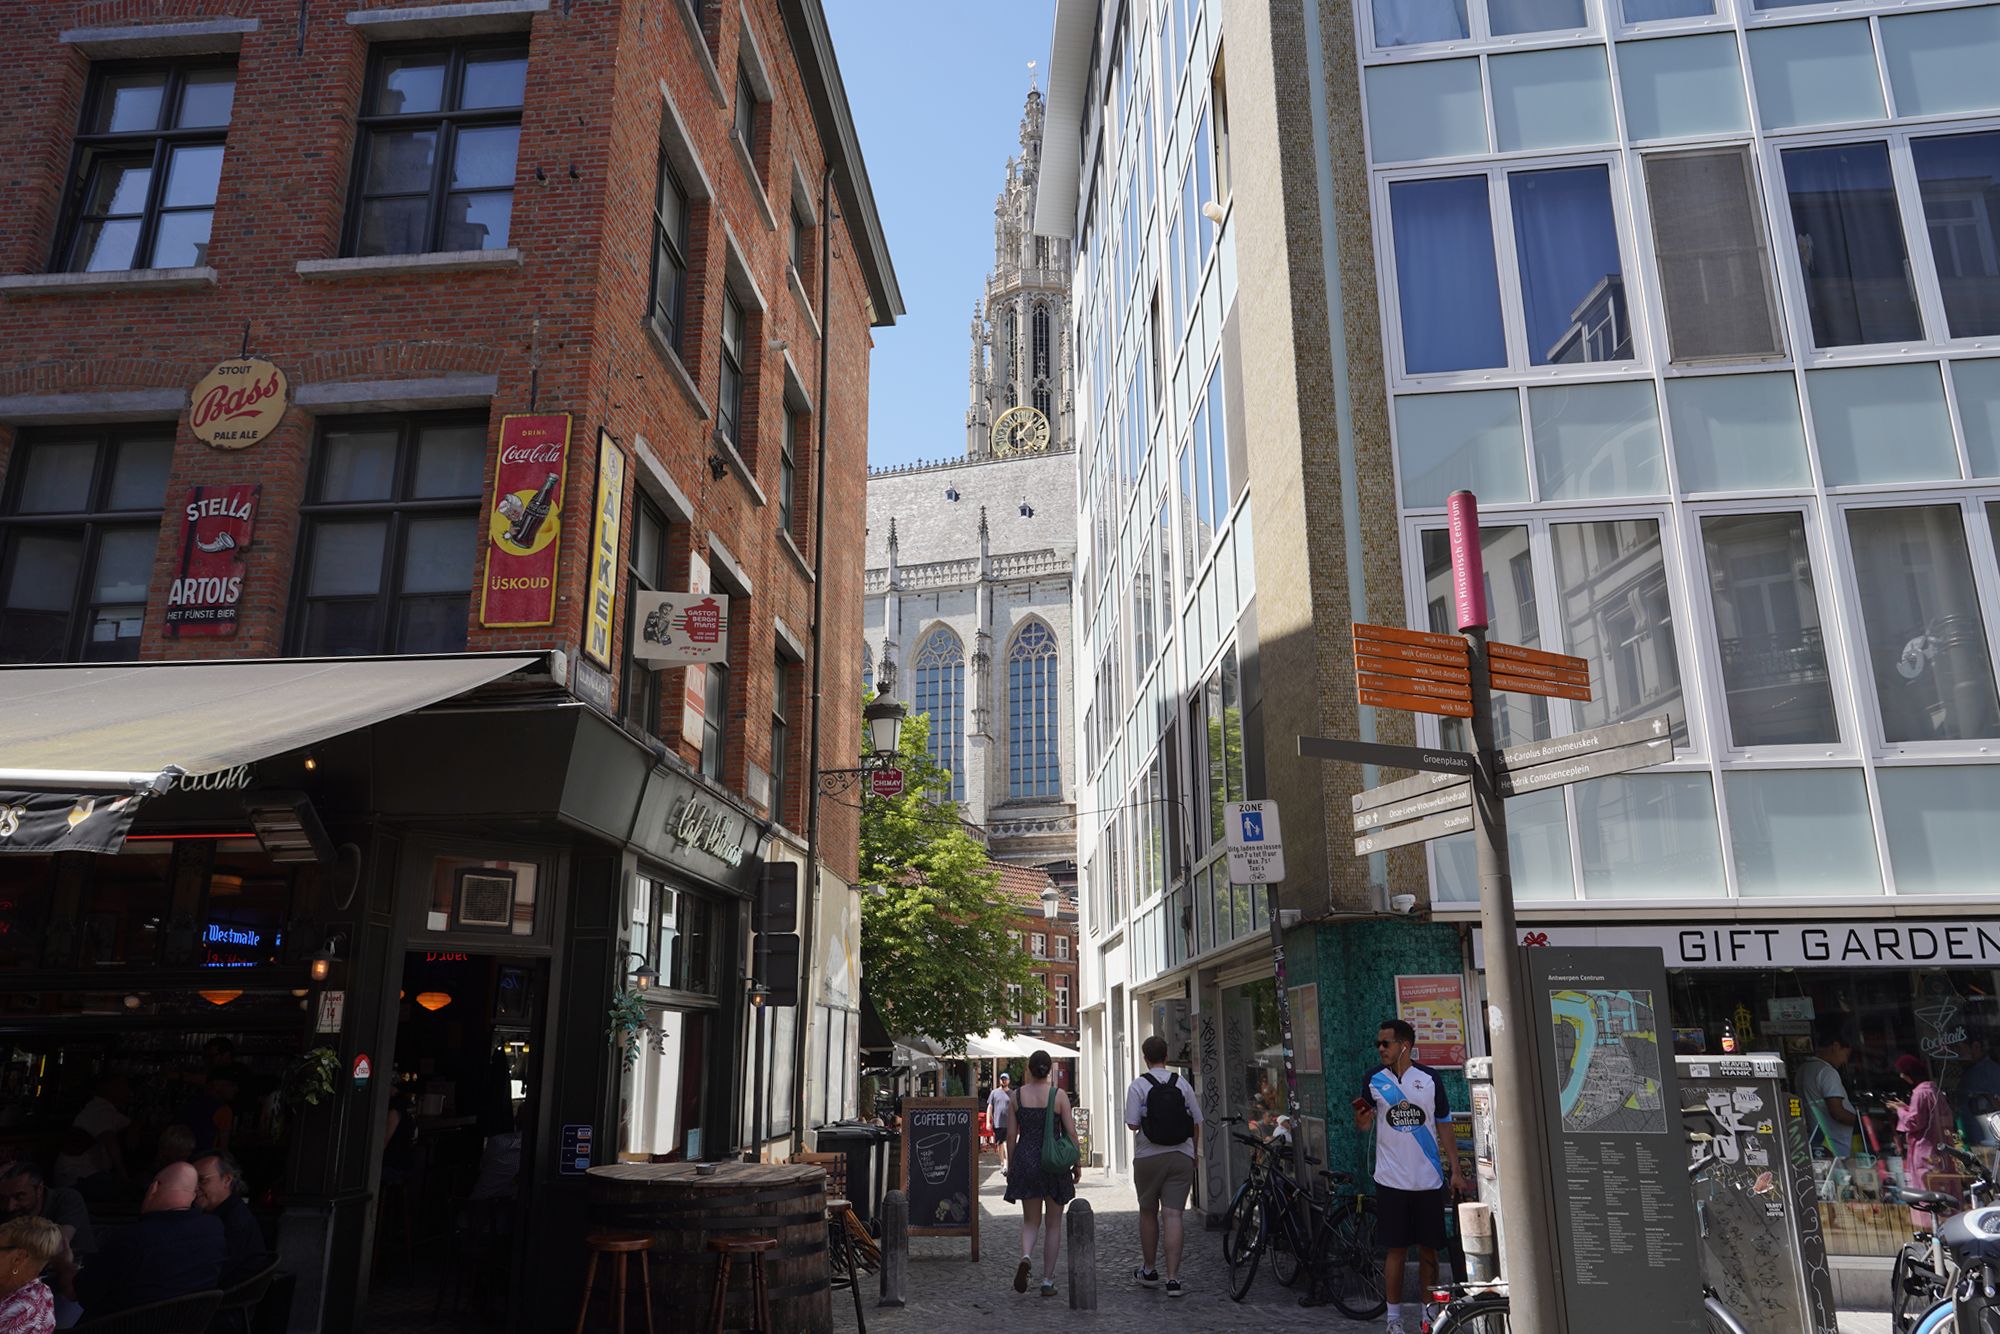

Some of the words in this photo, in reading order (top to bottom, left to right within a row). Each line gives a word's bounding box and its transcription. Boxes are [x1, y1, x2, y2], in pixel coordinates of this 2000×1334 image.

[218, 365, 252, 375] STOUT
[193, 371, 280, 428] Bass
[213, 431, 238, 440] PALE
[239, 430, 258, 439] ALE
[186, 492, 253, 522] STELLA
[1451, 500, 1462, 544] Centrum
[592, 490, 617, 656] ALKEN
[1455, 546, 1468, 599] Historisch
[168, 576, 241, 606] ARTOIS
[167, 610, 184, 621] HET
[217, 608, 236, 619] BIER
[1460, 599, 1471, 623] wijk
[1438, 637, 1449, 645] Het
[1449, 638, 1464, 647] Zuid
[1401, 649, 1415, 657] wijk
[1415, 650, 1441, 660] Centraal
[1442, 653, 1465, 663] Station
[1415, 667, 1429, 675] wijk
[1440, 704, 1453, 712] wijk
[1498, 748, 1541, 765] Sint-Carolus
[1542, 735, 1600, 756] Borromeuskerk
[1423, 754, 1468, 767] Groenplaats
[1501, 775, 1529, 789] Hendrik
[1529, 763, 1590, 784] Conscienceplein
[1238, 803, 1263, 812] ZONE
[1443, 815, 1470, 828] Stadhuis
[209, 924, 260, 946] Westmalle
[1678, 929, 1780, 962] GIFT
[1801, 926, 2000, 961] GARDEN
[1548, 974, 1580, 982] Antwerpen
[1580, 974, 1605, 982] Centrum
[1921, 1025, 1968, 1052] Cocktails
[913, 1112, 946, 1127] COFFEE
[946, 1112, 957, 1126] TO
[957, 1112, 969, 1125] GO
[1391, 1108, 1421, 1118] Estrella
[1392, 1117, 1420, 1127] Galicia
